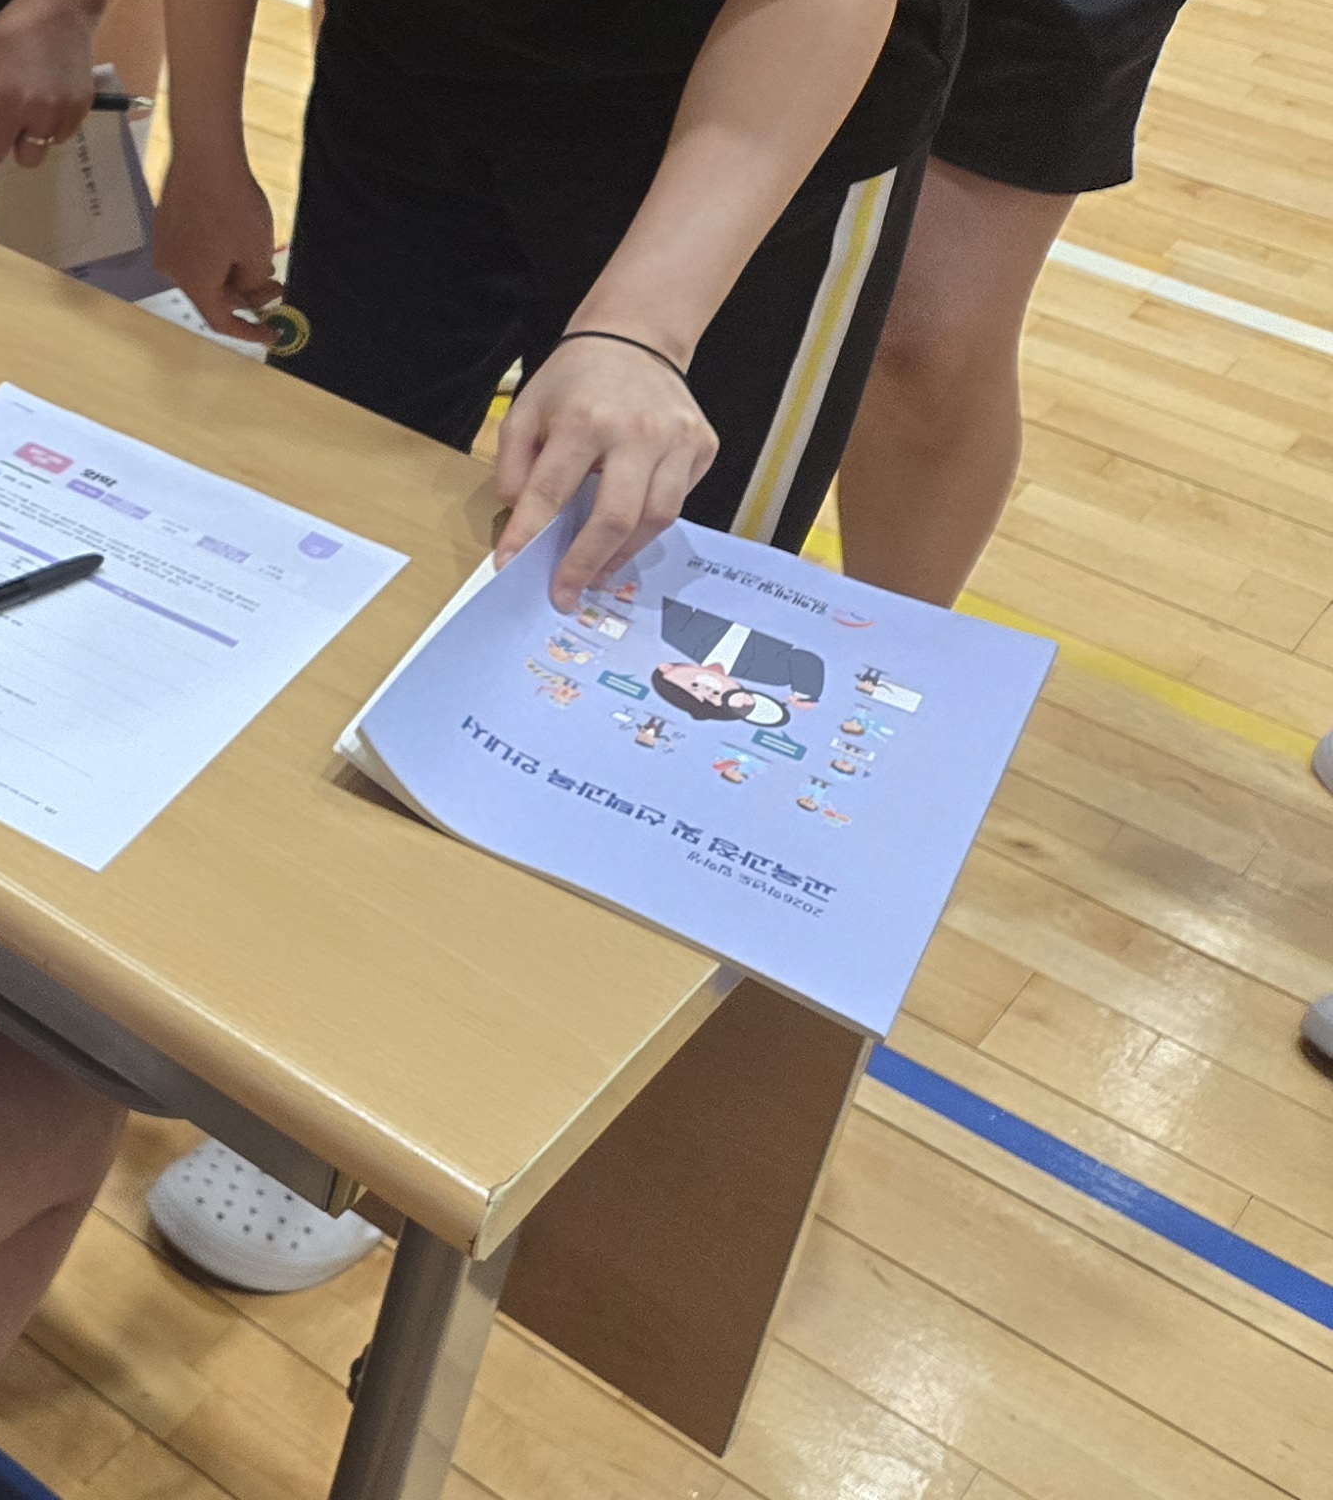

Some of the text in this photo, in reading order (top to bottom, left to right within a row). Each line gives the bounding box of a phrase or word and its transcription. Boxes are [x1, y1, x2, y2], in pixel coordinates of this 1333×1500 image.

[460, 714, 837, 903] 교육과정 및 선택과목 안내서
